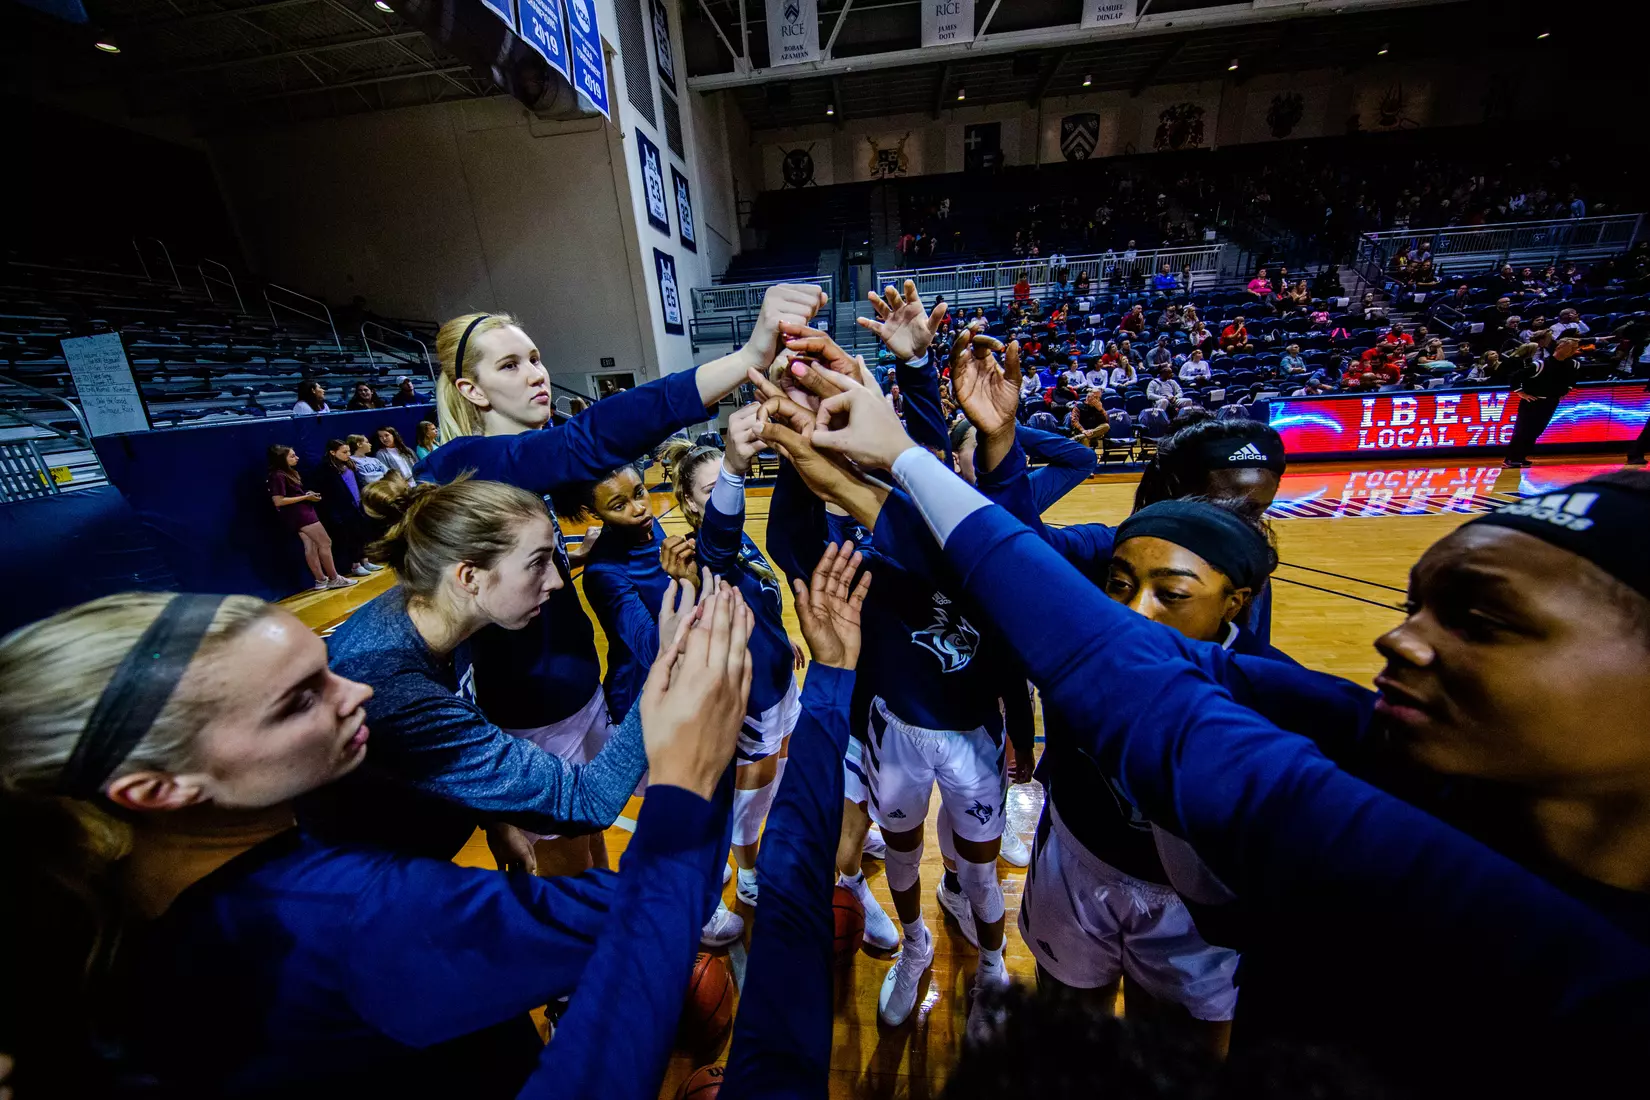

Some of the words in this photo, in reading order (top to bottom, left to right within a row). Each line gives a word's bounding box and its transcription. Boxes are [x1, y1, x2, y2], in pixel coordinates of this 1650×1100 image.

[936, 2, 961, 16] RICE
[1097, 4, 1124, 12] SAMUEL
[1096, 12, 1123, 21] DUNLAP
[532, 16, 559, 56] 2019
[781, 22, 805, 37] RICE
[938, 24, 957, 33] JAMES
[938, 32, 956, 40] DOTY
[582, 68, 602, 100] 2019
[649, 176, 661, 203] 23
[665, 286, 676, 308] 25
[1360, 391, 1517, 427] I.B.E.W.
[1357, 426, 1455, 450] LOCAL
[1228, 453, 1268, 461] adidas
